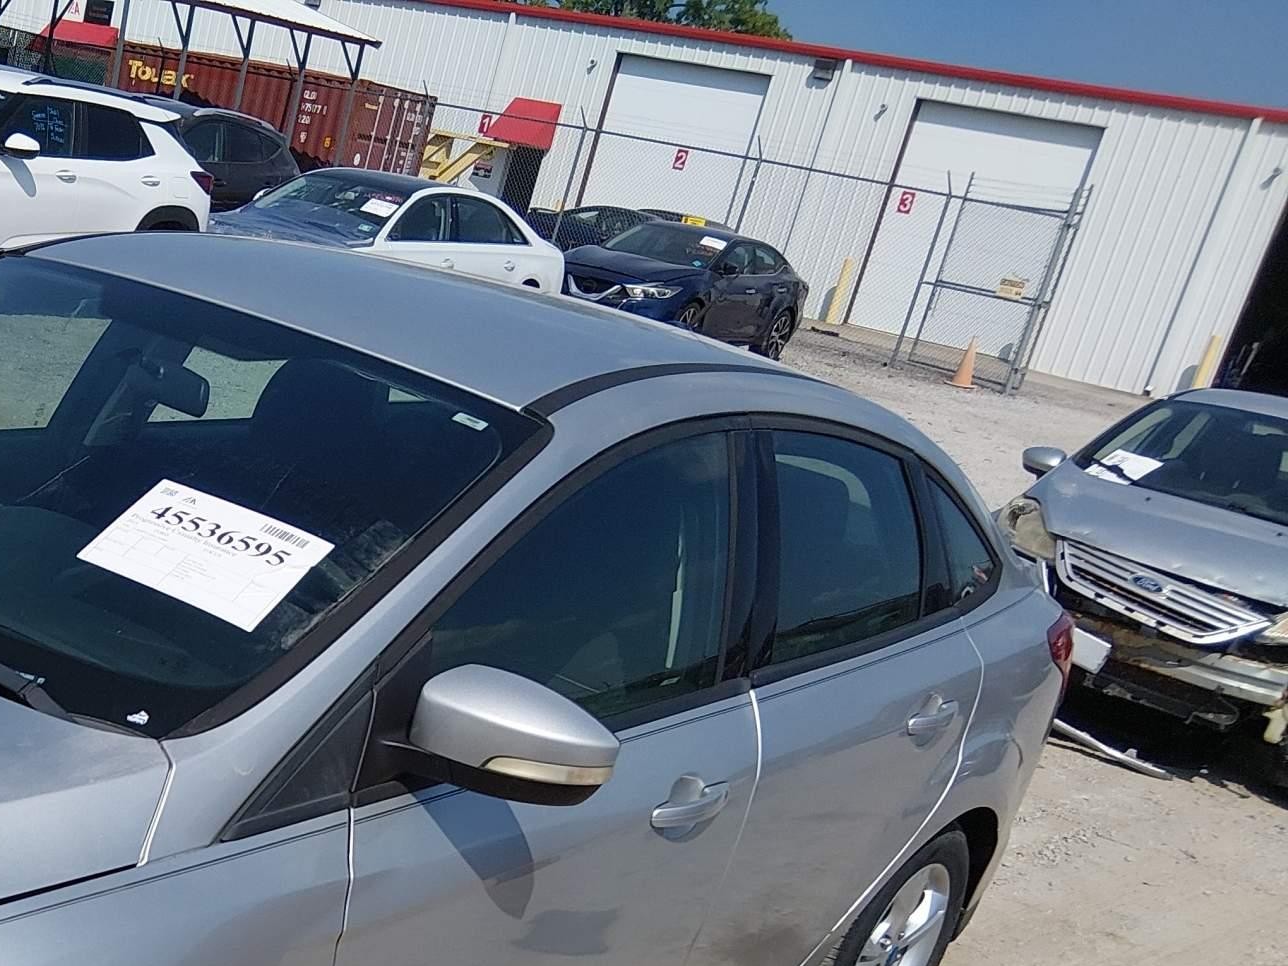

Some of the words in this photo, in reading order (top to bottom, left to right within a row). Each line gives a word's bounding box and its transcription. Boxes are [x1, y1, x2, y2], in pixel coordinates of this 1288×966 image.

[482, 117, 490, 132] 1
[674, 151, 687, 169] 2
[899, 193, 913, 212] 3
[150, 505, 292, 567] 45536595
